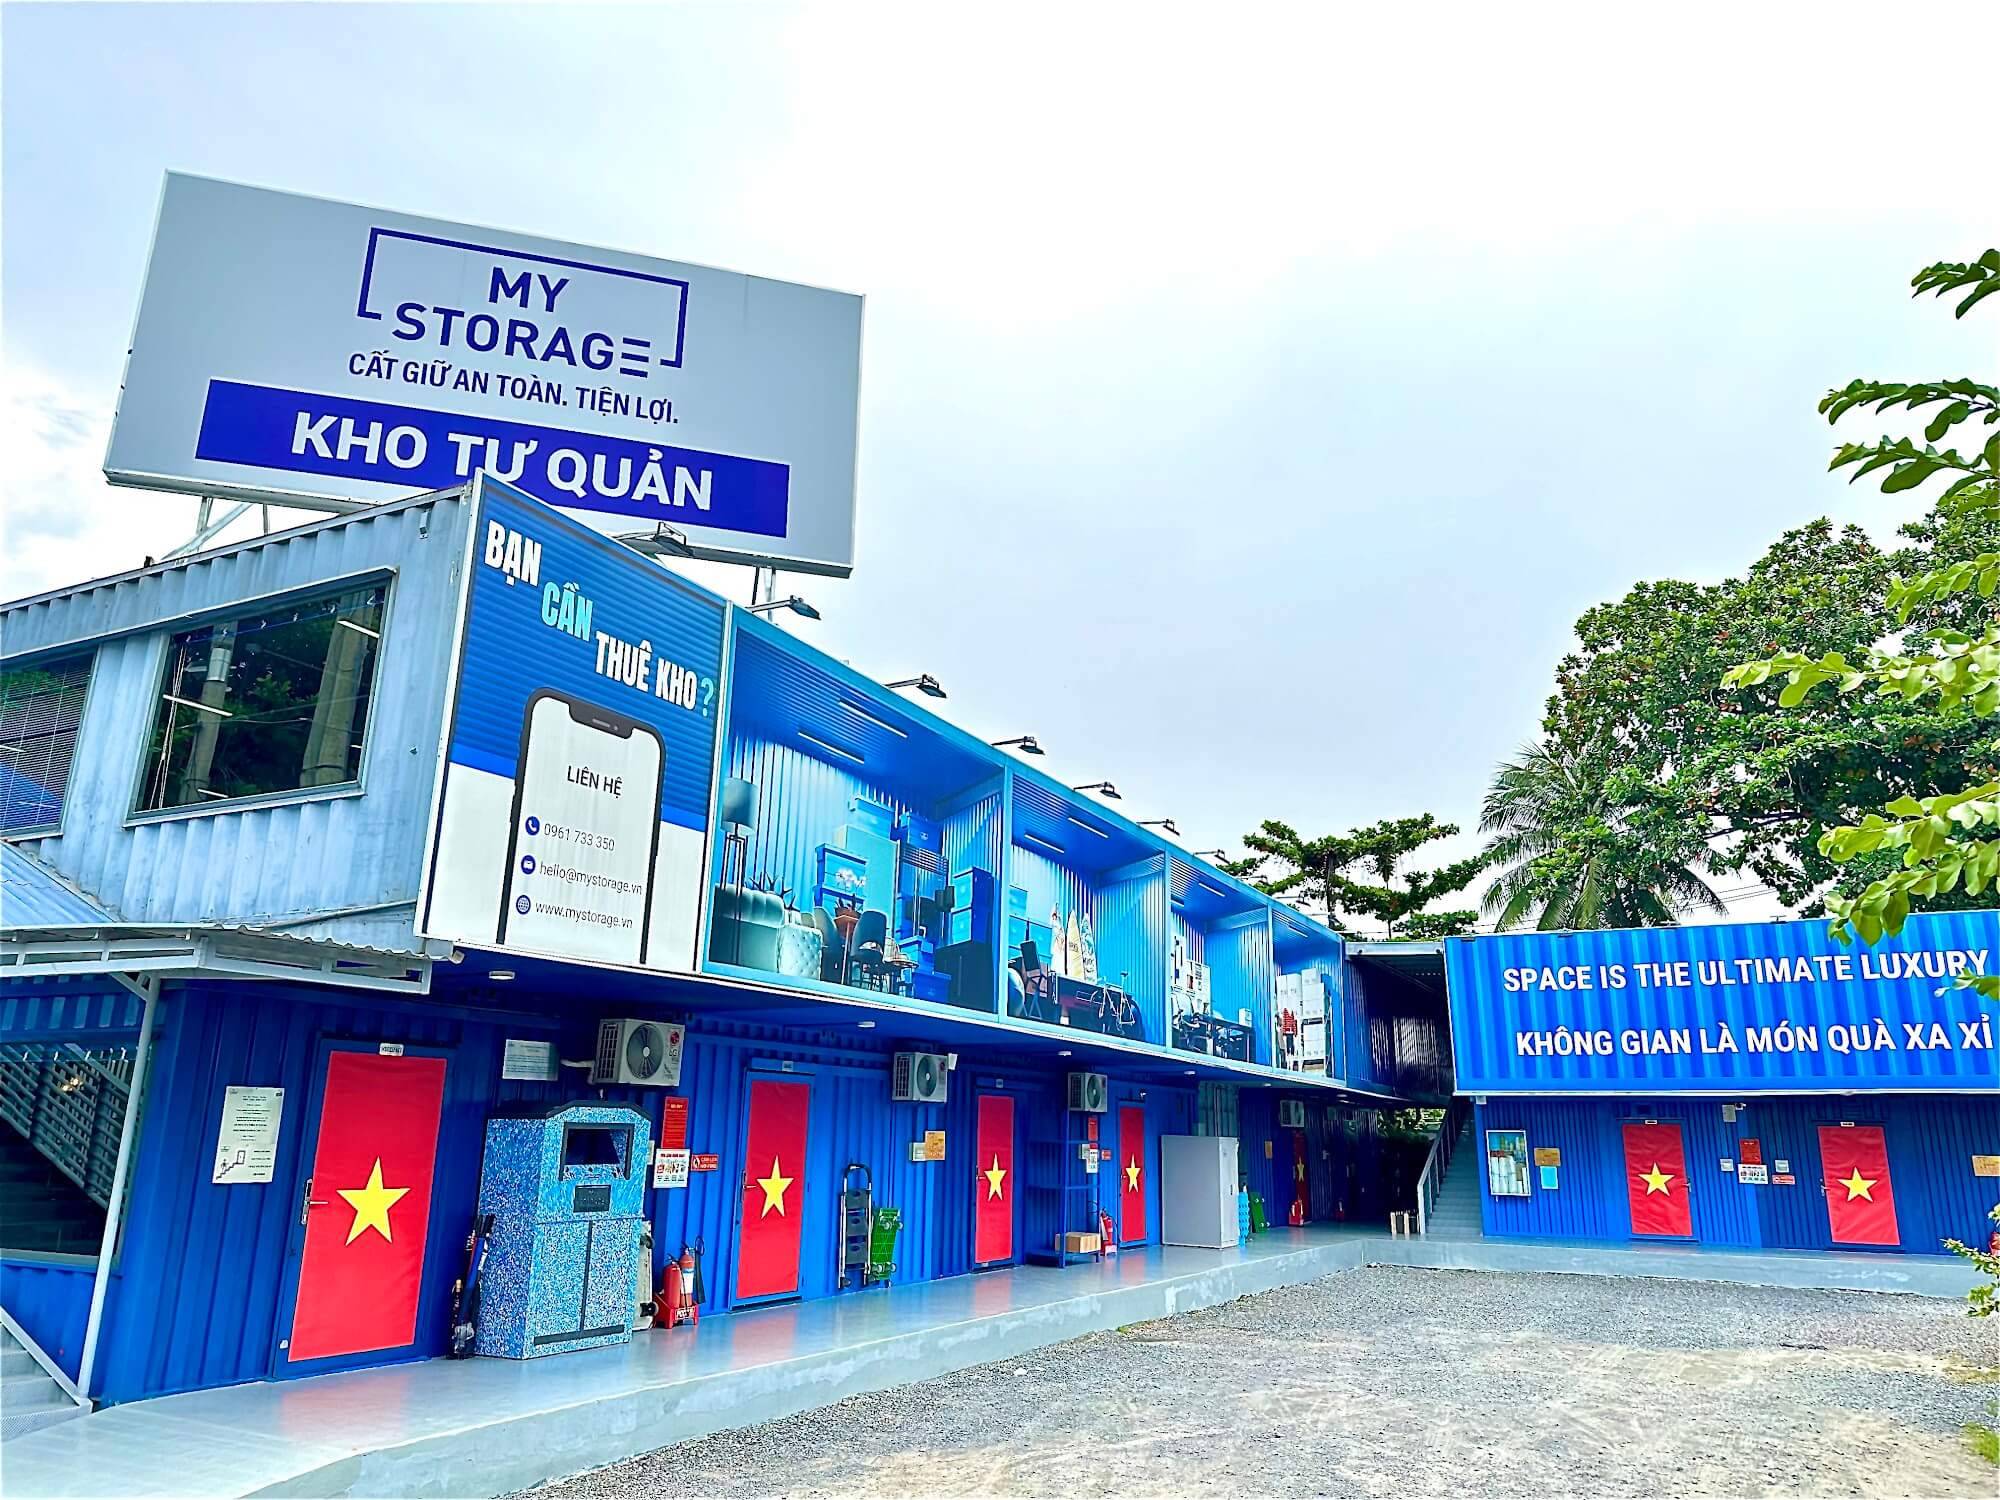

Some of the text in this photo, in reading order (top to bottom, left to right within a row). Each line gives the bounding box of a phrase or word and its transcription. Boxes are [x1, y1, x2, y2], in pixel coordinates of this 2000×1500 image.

[488, 266, 570, 312] MY
[392, 302, 650, 378] STORAGE
[349, 350, 678, 424] CẤT GIỮ AN TOÀN. TIỆN LỢI.
[291, 411, 713, 511] KHO TƯ QUẢN
[484, 520, 542, 586] BẠN
[541, 582, 593, 641] CẦN
[594, 631, 653, 692] THUÊ
[567, 765, 623, 799] LIÊN HỆ
[544, 823, 615, 851] 0961 733 350
[539, 861, 643, 895] hello@mystorage.vn
[535, 901, 633, 929] www.mystorage.vn
[1502, 949, 1989, 992] SPACE IS THE ULTIMATE LUXURY
[1516, 1013, 1994, 1056] KHÔNG GIAN LÀ MÓN QUÀ XA XỈ
